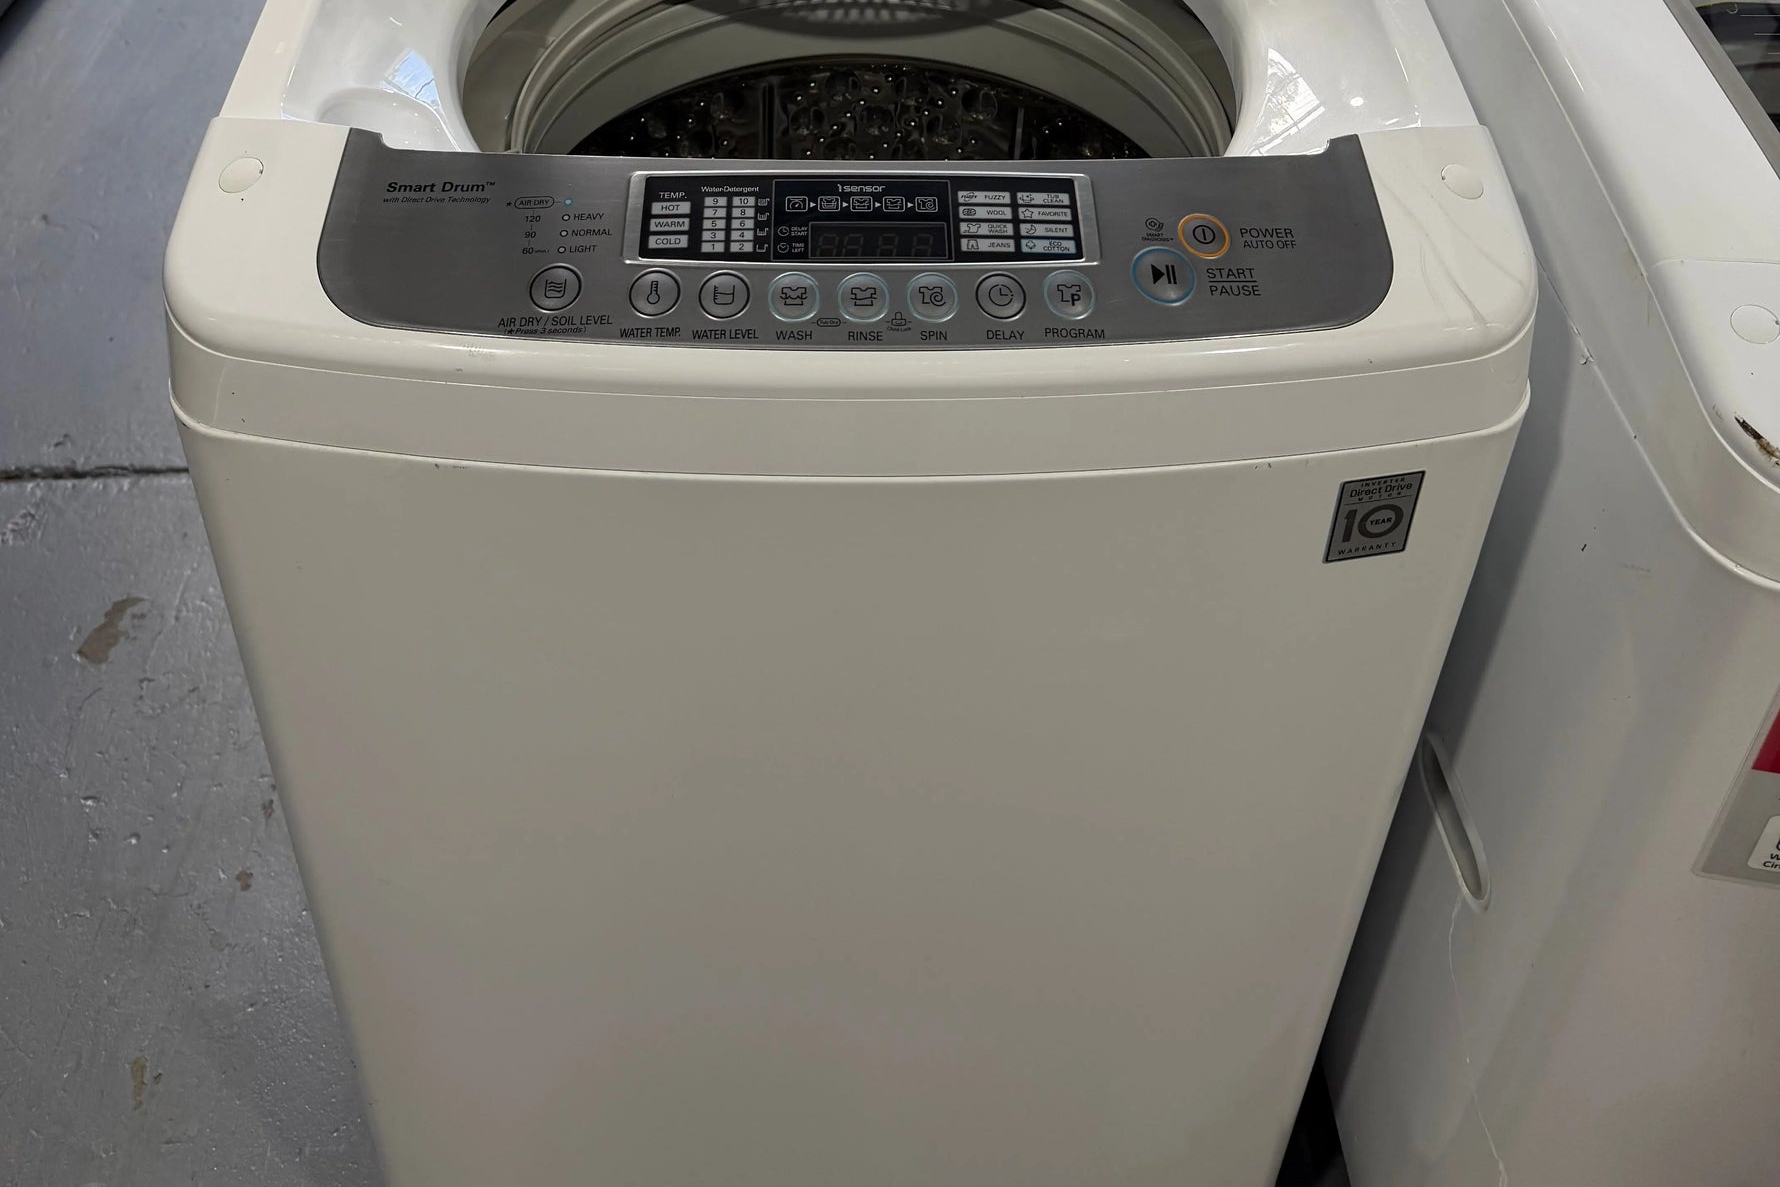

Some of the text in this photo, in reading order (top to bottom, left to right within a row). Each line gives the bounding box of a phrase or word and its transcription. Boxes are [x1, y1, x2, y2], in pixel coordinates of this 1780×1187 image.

[386, 181, 436, 193] Smart
[448, 196, 491, 204] Technology
[659, 191, 688, 199] TEMP.
[524, 215, 541, 223] 120
[573, 213, 604, 221] HEAVY
[655, 220, 685, 228] WARM
[571, 229, 613, 237] NORMAL
[1239, 227, 1294, 239] POWER
[655, 237, 681, 245] COLD
[1243, 239, 1297, 249] AUTO OFF
[569, 245, 597, 253] LIGHT
[1206, 267, 1255, 279] START
[1209, 285, 1262, 297] PAUSE
[497, 317, 517, 328] AIR
[519, 316, 542, 326] DRY
[551, 315, 576, 326] SOIL
[580, 314, 613, 325] LEVEL
[619, 326, 681, 338] WATER TEMP.
[692, 328, 759, 340] WATER LEVEL
[775, 330, 813, 341] WASH
[848, 330, 883, 341] RINSE
[920, 330, 948, 341] SPIN
[986, 329, 1025, 340] DELAY
[1044, 327, 1105, 340] PROGRAM
[1349, 482, 1413, 498] Direct Drive
[1341, 504, 1404, 543] 10
[1369, 517, 1393, 526] YEAR
[1337, 541, 1397, 555] WARRANTY
